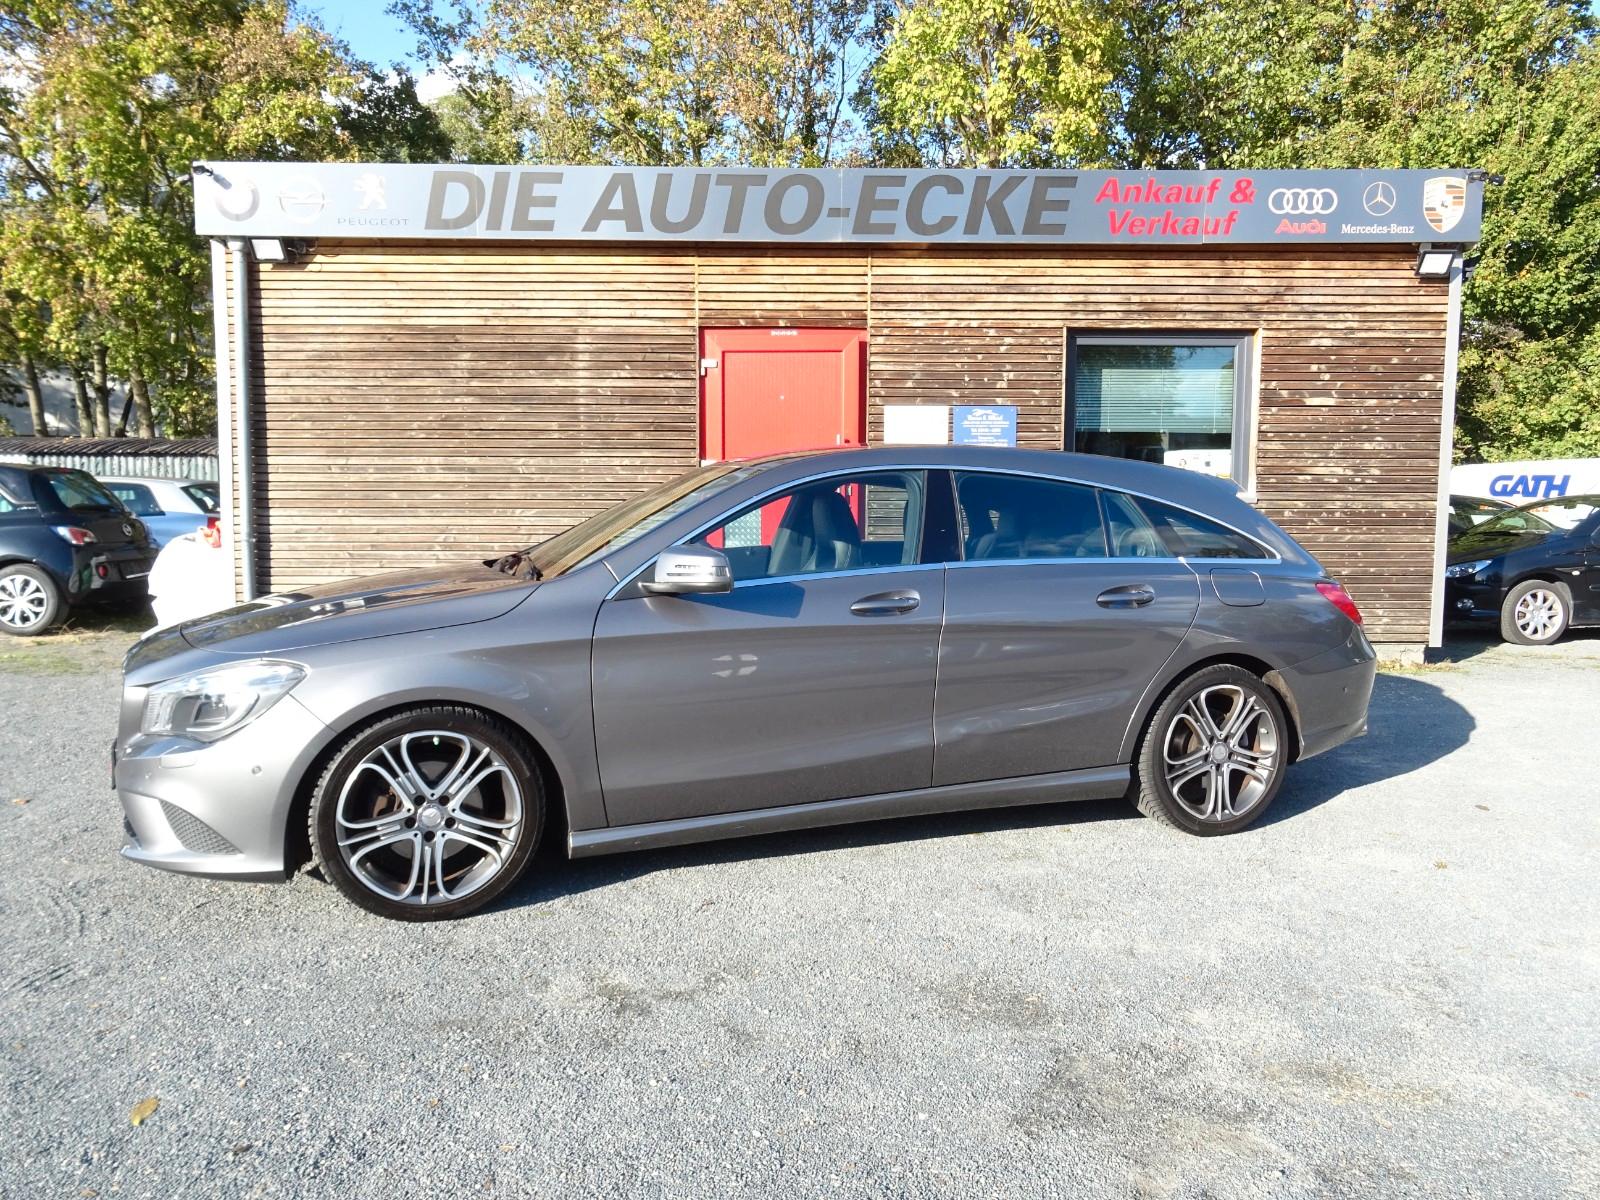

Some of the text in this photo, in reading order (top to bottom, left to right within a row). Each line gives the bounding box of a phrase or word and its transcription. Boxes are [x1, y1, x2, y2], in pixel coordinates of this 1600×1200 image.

[424, 170, 1078, 236] DIE AUTO-ECKE
[1096, 177, 1257, 205] Ankauf &
[336, 217, 409, 226] PEUGEOT
[1108, 209, 1240, 236] Verkauf
[1274, 218, 1327, 234] Audi
[1341, 223, 1415, 235] Mercedes-Benz
[1488, 474, 1571, 498] GATH
